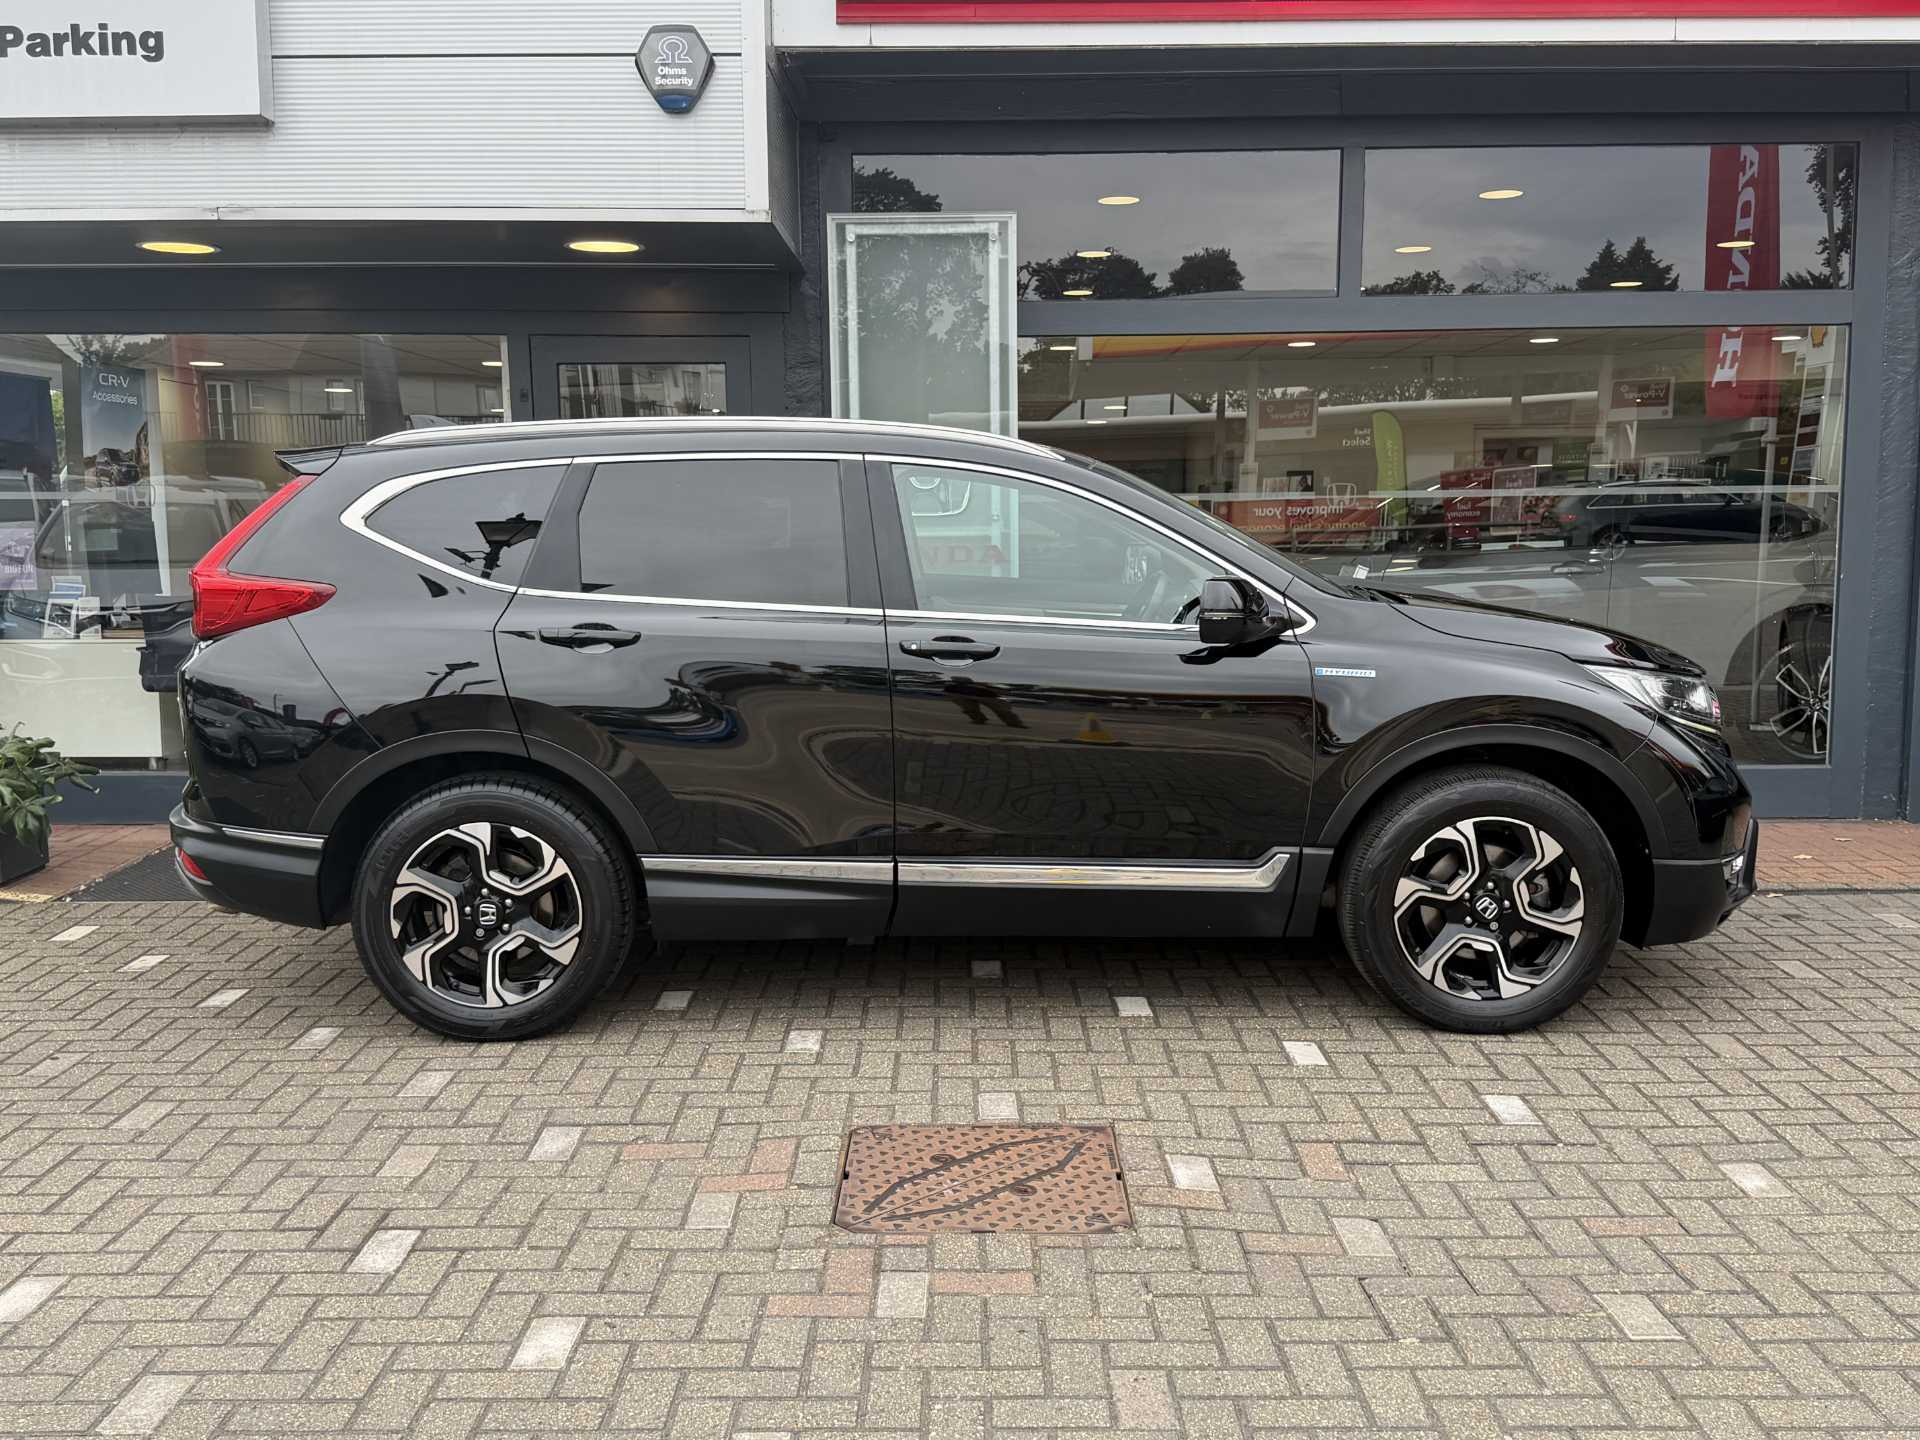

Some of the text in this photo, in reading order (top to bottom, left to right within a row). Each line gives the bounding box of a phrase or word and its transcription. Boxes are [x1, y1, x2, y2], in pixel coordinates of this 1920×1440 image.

[0, 23, 165, 63] Parking
[657, 66, 687, 75] Ohms
[655, 77, 694, 87] Security
[92, 391, 138, 405] Accessories
